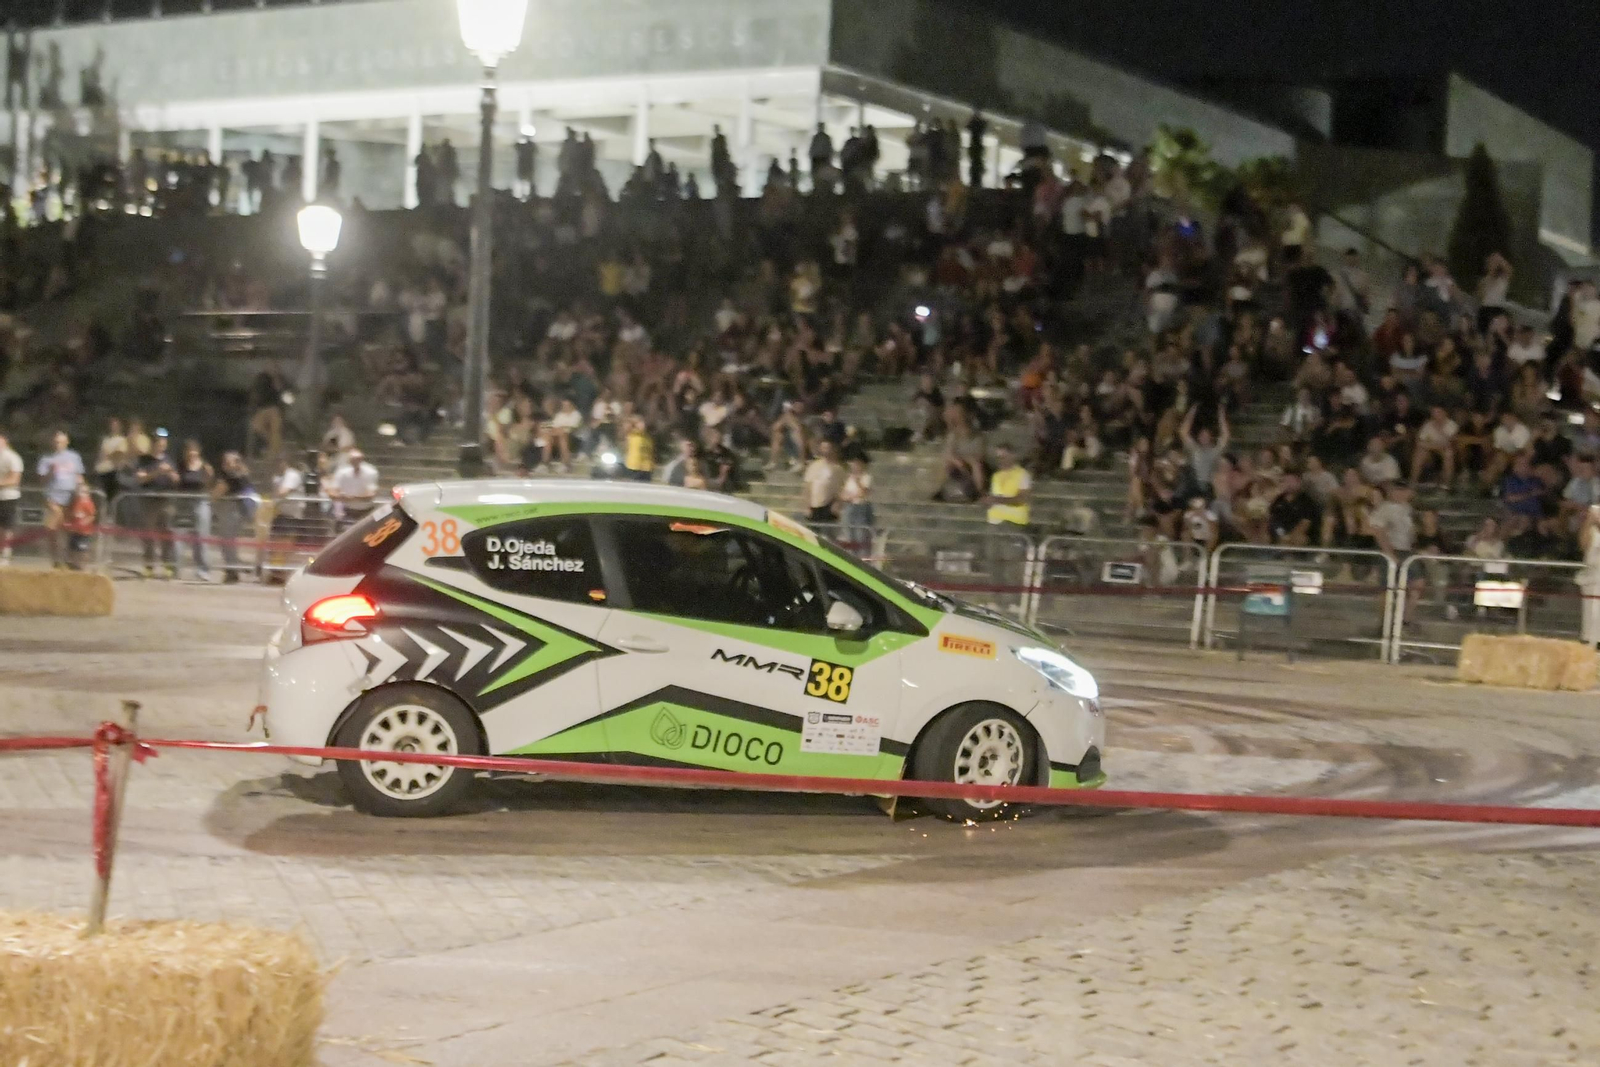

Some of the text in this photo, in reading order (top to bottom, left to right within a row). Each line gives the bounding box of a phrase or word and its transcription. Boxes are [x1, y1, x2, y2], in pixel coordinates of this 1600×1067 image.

[421, 518, 461, 557] 38
[486, 536, 556, 557] D.Ojeda
[487, 554, 585, 572] J. Sánchez
[942, 636, 991, 655] PIRELLI
[710, 648, 805, 681] MMR
[806, 661, 852, 702] 38
[691, 724, 784, 766] DIOCO
